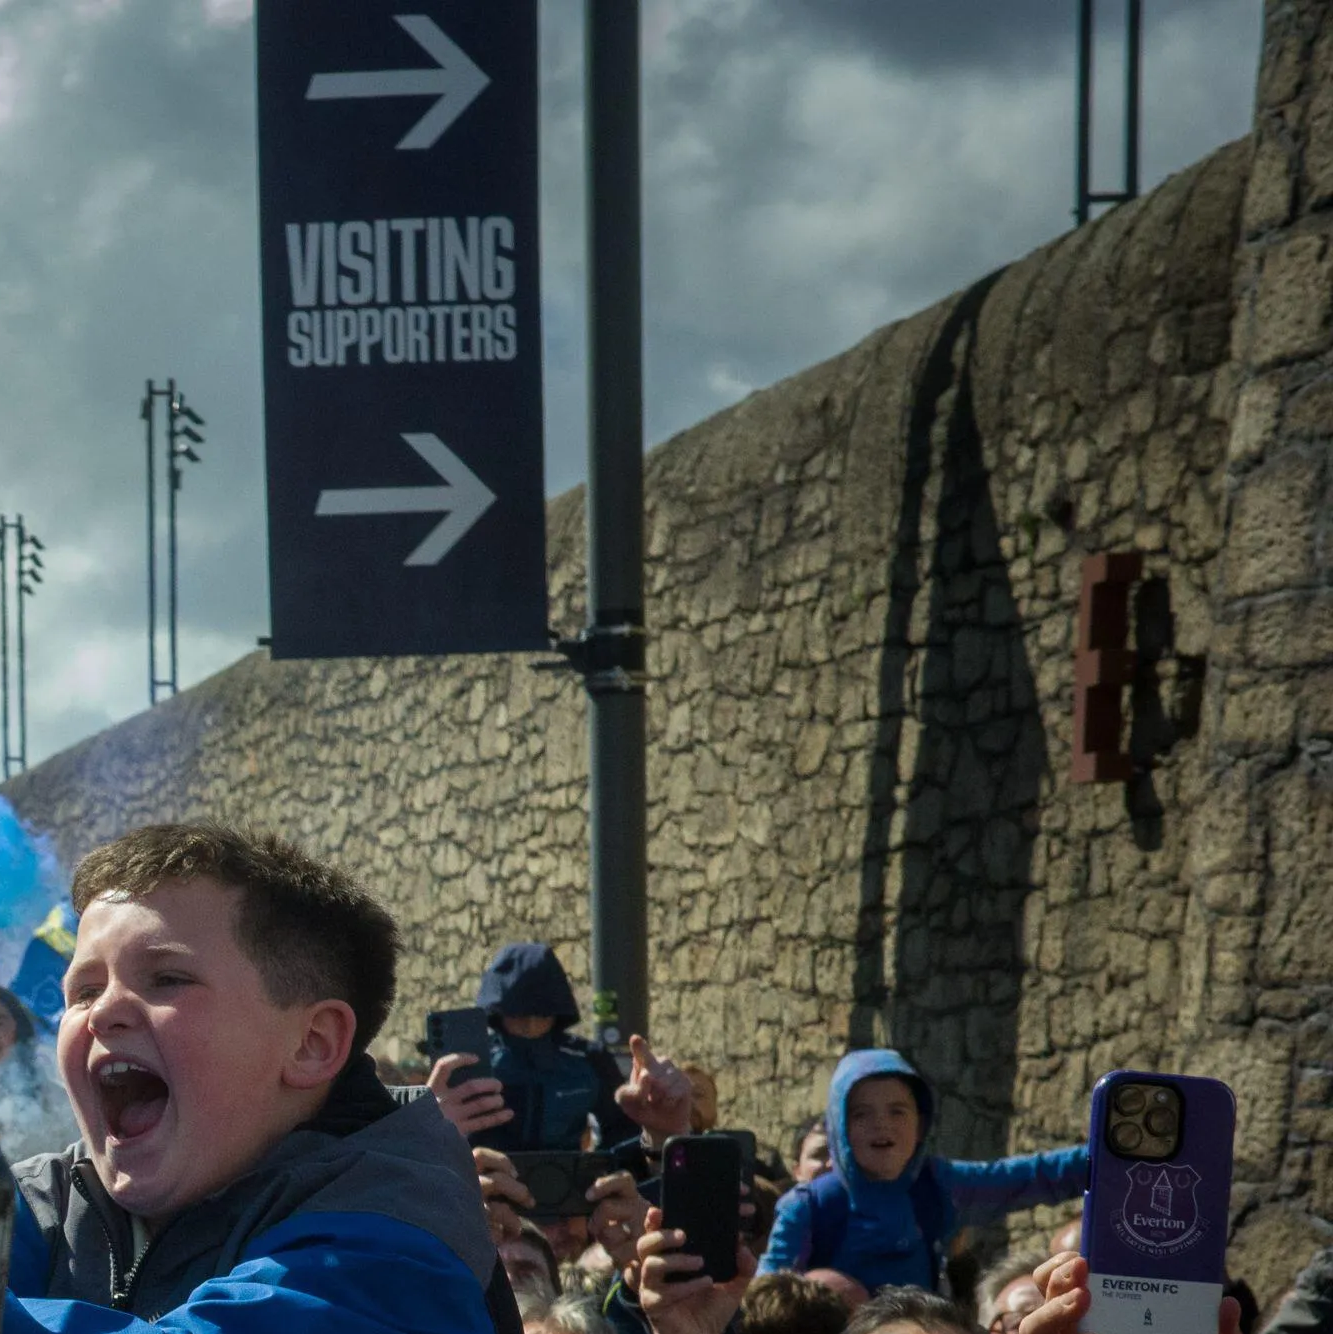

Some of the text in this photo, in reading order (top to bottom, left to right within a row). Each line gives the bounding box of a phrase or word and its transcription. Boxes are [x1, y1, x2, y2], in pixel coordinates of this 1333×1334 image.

[285, 216, 515, 307] VISITING
[287, 303, 518, 367] SUPPORTERS
[1133, 1213, 1185, 1230] Everton
[1102, 1279, 1179, 1295] EVERTON FC
